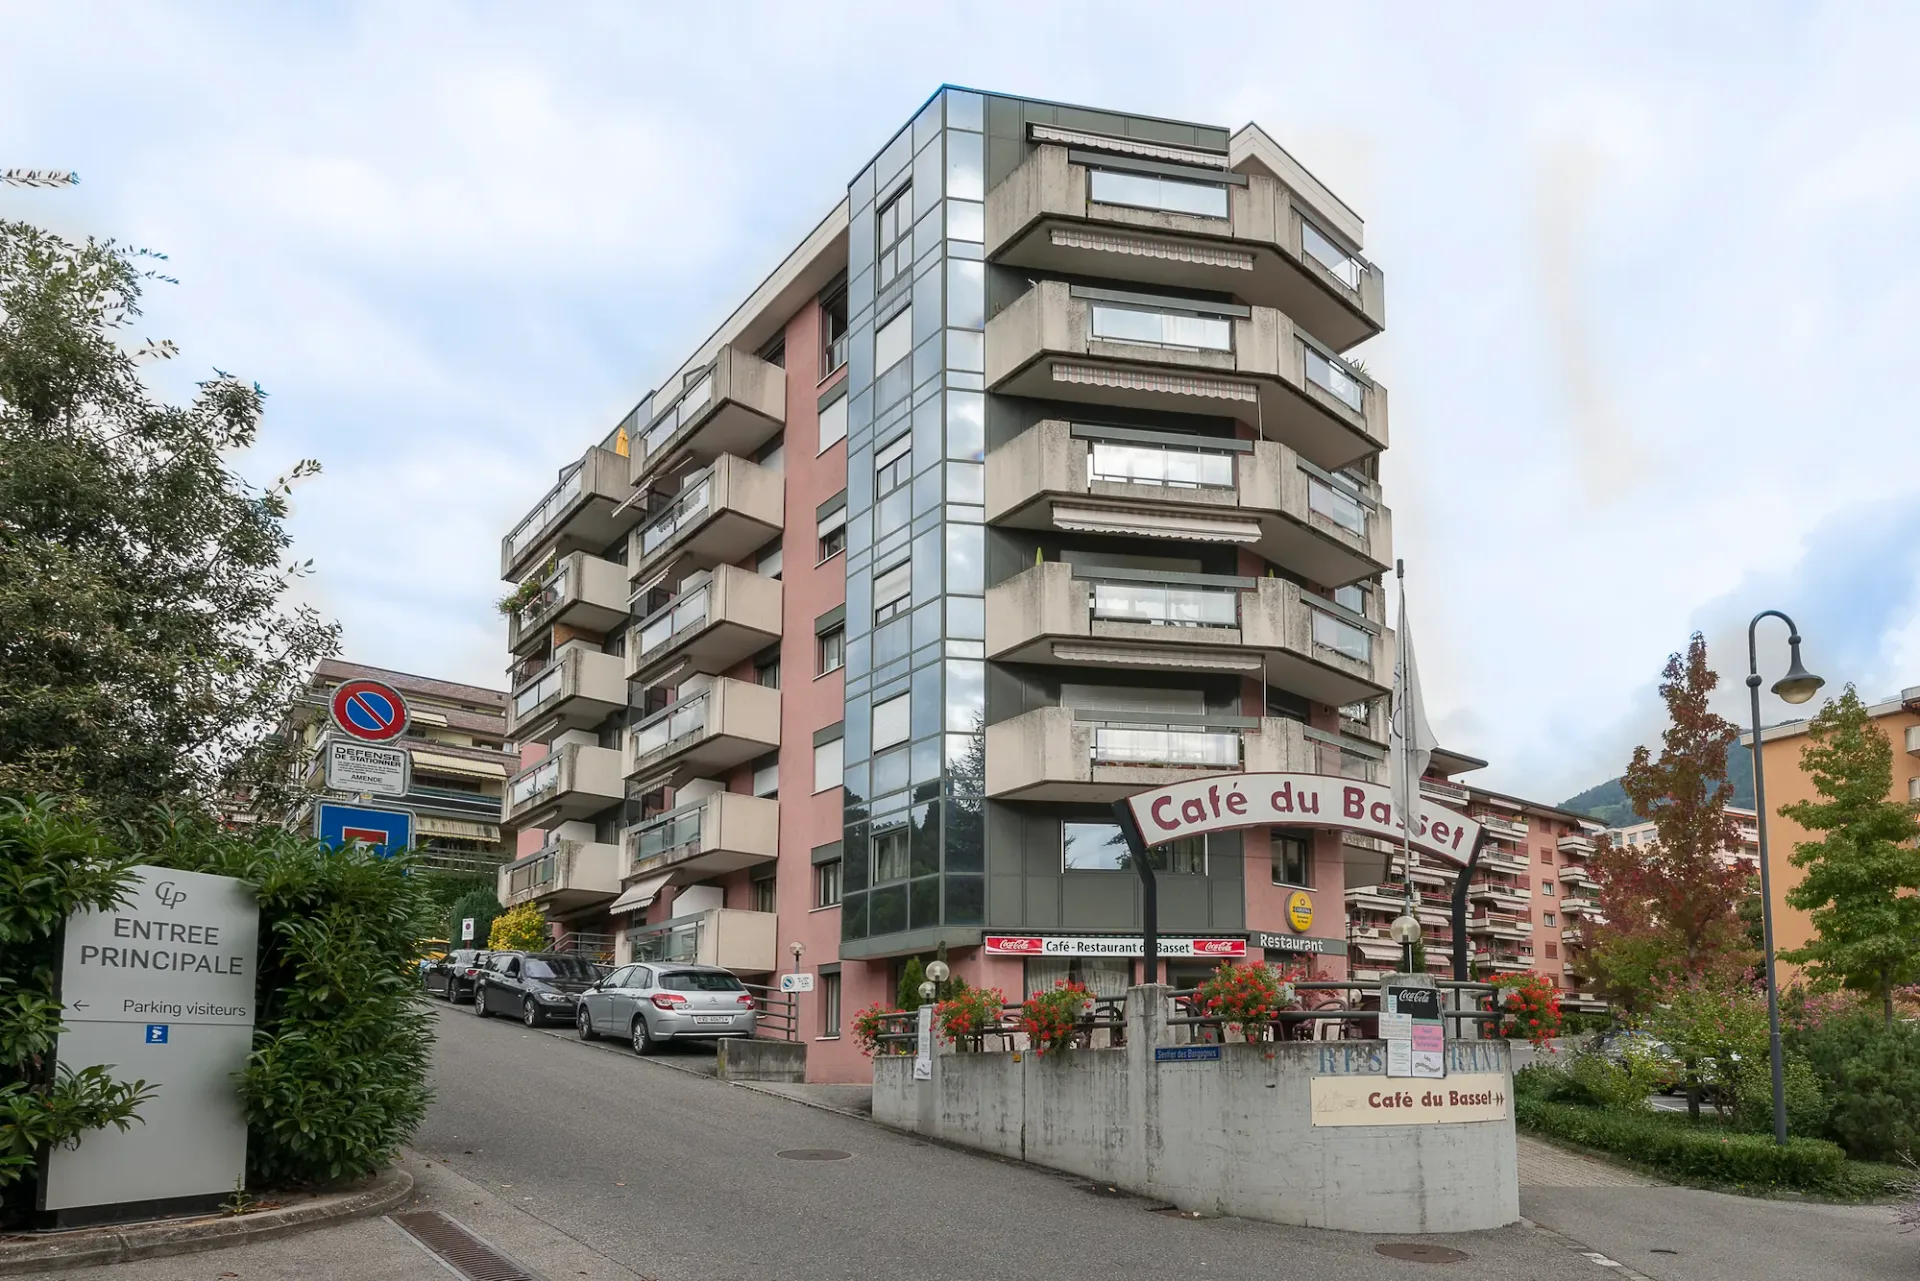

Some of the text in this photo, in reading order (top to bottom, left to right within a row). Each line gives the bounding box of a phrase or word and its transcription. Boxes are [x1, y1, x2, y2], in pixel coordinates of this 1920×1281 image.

[336, 747, 400, 762] DEFENSE
[349, 756, 401, 767] STATIONNER
[351, 774, 383, 783] AMENDE
[1151, 782, 1247, 830] Café
[1271, 781, 1320, 815] du
[114, 918, 219, 945] ENTREE
[1260, 933, 1323, 952] Restaurant
[81, 945, 243, 975] PRINCIPALE
[123, 1000, 246, 1017] Parking visiteurs
[1368, 1091, 1413, 1108] Café
[1421, 1091, 1443, 1107] du
